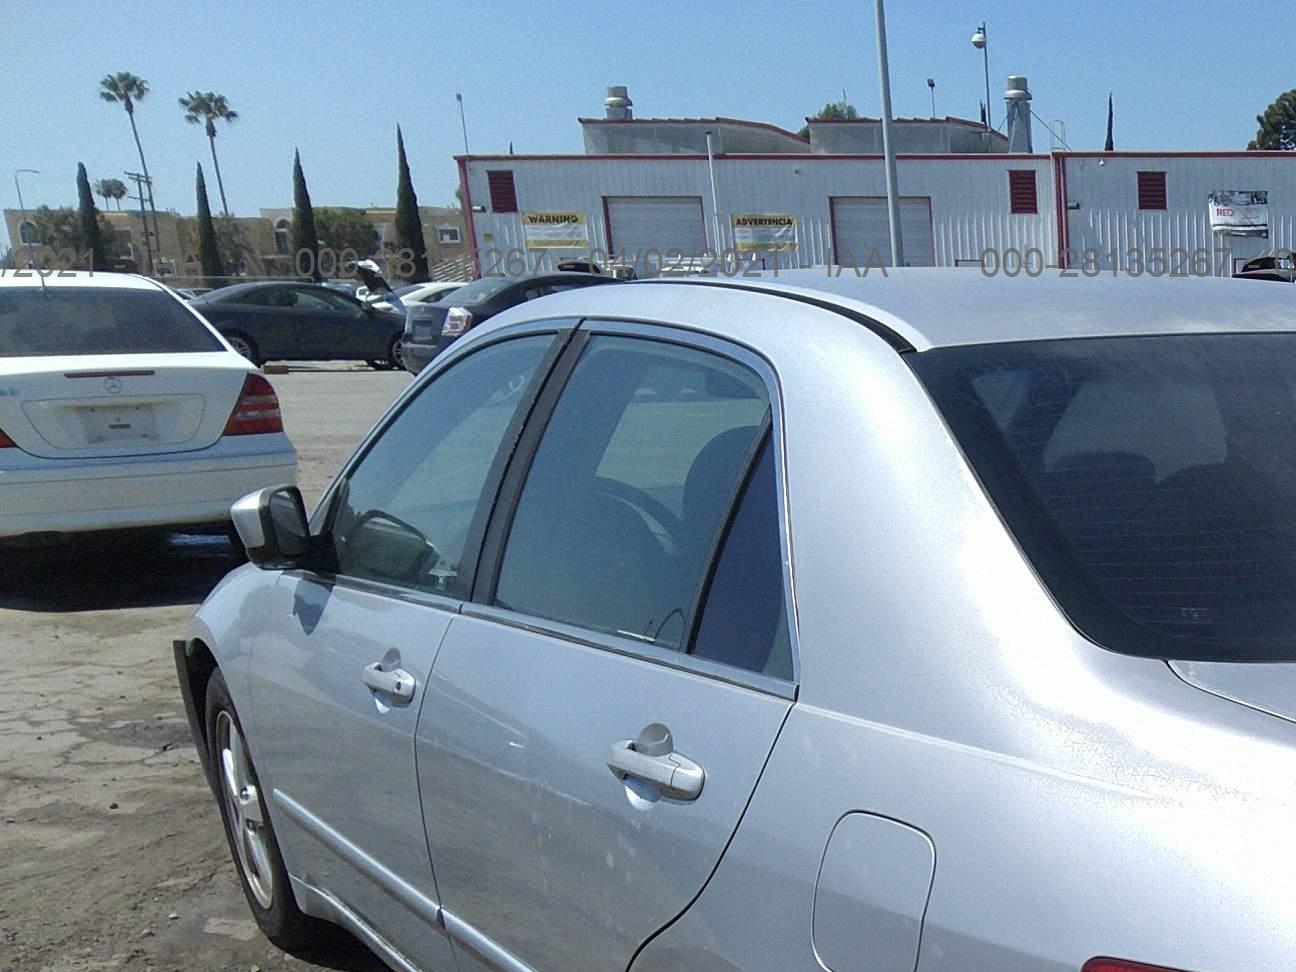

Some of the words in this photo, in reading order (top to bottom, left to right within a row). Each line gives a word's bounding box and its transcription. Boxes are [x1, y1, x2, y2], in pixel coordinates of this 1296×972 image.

[1216, 208, 1233, 217] RED
[528, 214, 579, 224] WARNING
[736, 217, 793, 226] ADVERTENCIA
